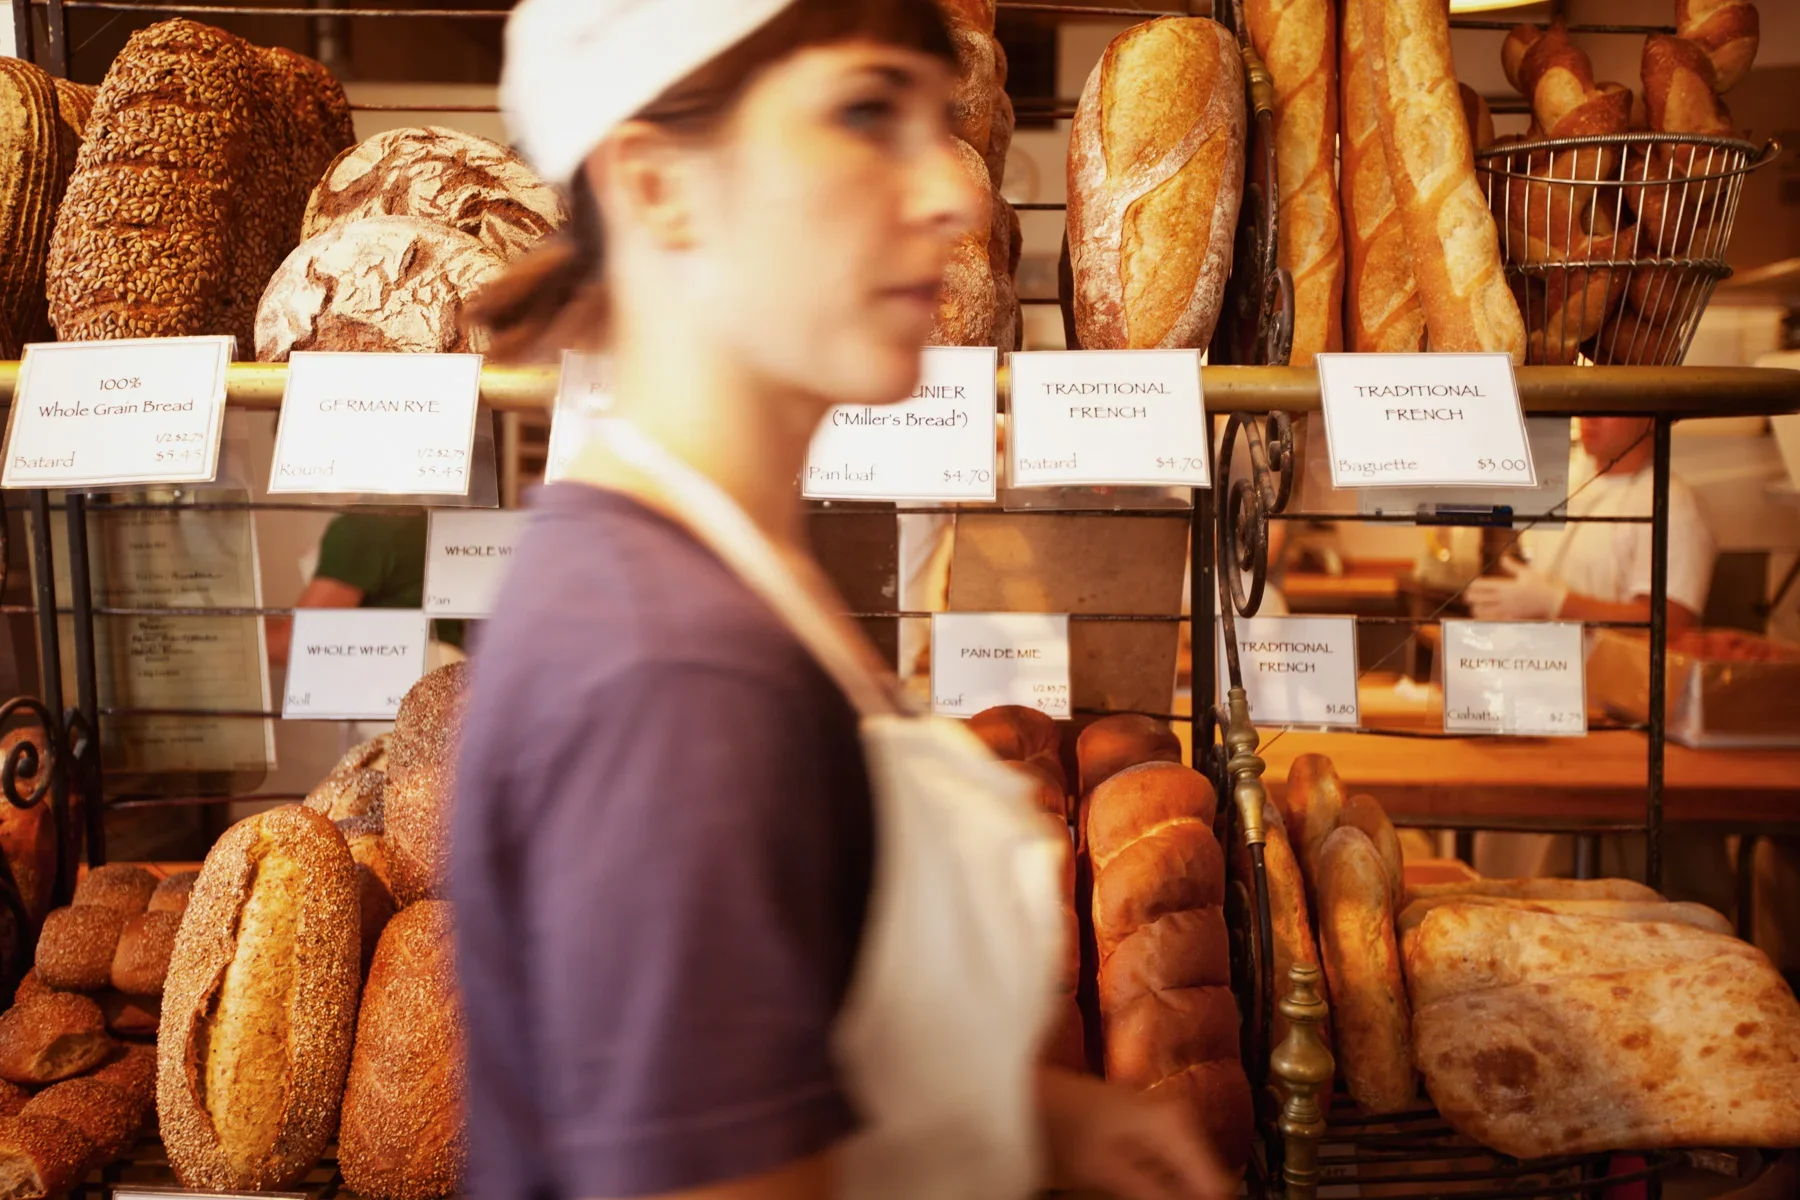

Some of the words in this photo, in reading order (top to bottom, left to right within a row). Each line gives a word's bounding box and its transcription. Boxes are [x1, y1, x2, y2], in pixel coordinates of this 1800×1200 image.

[100, 376, 142, 391] 100%
[1041, 381, 1173, 396] TRADITIONAL
[1354, 384, 1486, 398] TRADITIONAL
[910, 385, 966, 400] UNIER
[39, 400, 89, 418] Whole
[93, 400, 138, 416] Grain
[142, 396, 194, 413] Bread
[319, 398, 400, 413] GERMAN
[404, 400, 441, 413] RYE
[1069, 406, 1147, 419] FRENCH
[832, 407, 901, 427] ("Miller's
[906, 409, 968, 428] Bread")
[1385, 408, 1464, 421] FRENCH
[13, 450, 76, 469] Batard
[1019, 452, 1077, 471] Batard
[1155, 456, 1203, 472] $4.70
[279, 459, 335, 477] Round
[417, 465, 463, 478] $5.45
[809, 466, 840, 481] Pan
[844, 463, 877, 481] loaf
[943, 469, 990, 486] $4.70
[1338, 459, 1419, 477] Baguette
[1477, 458, 1526, 472] $3.00
[445, 545, 496, 557] WHOLE
[307, 645, 357, 656] WHOLE
[359, 645, 408, 656] WHEAT
[961, 647, 991, 660] PAIN
[994, 648, 1014, 660] DE
[1017, 648, 1041, 660] MIE
[1240, 642, 1333, 653] TRADITIONAL
[1259, 662, 1315, 673] FRENCH
[1460, 657, 1511, 669] RUSTIC
[1514, 658, 1567, 671] ITALIAN
